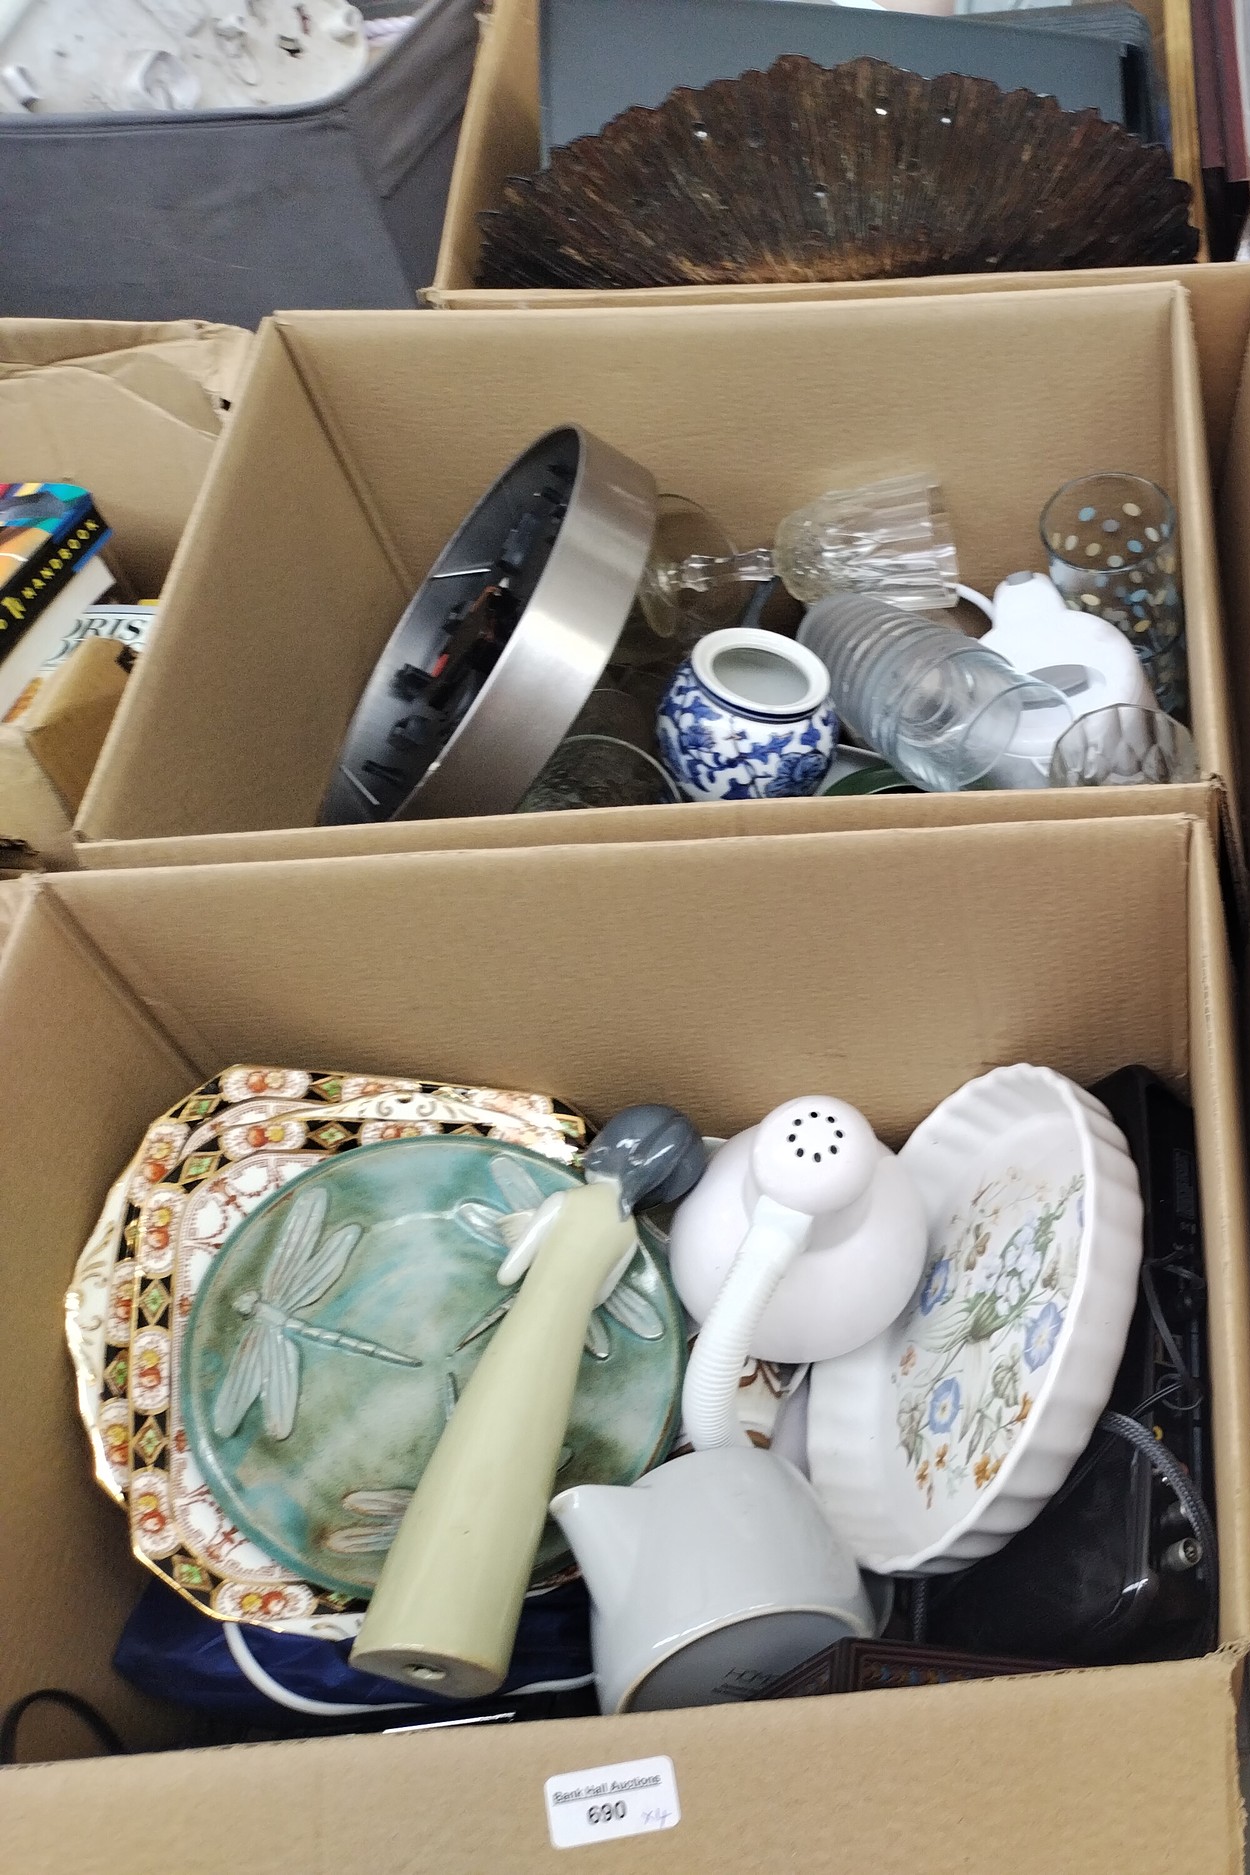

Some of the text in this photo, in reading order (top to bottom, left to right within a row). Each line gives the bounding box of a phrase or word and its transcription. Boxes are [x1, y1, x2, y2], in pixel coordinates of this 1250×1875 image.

[553, 1775, 661, 1802] Bank Hall Auctions
[588, 1800, 626, 1824] 690
